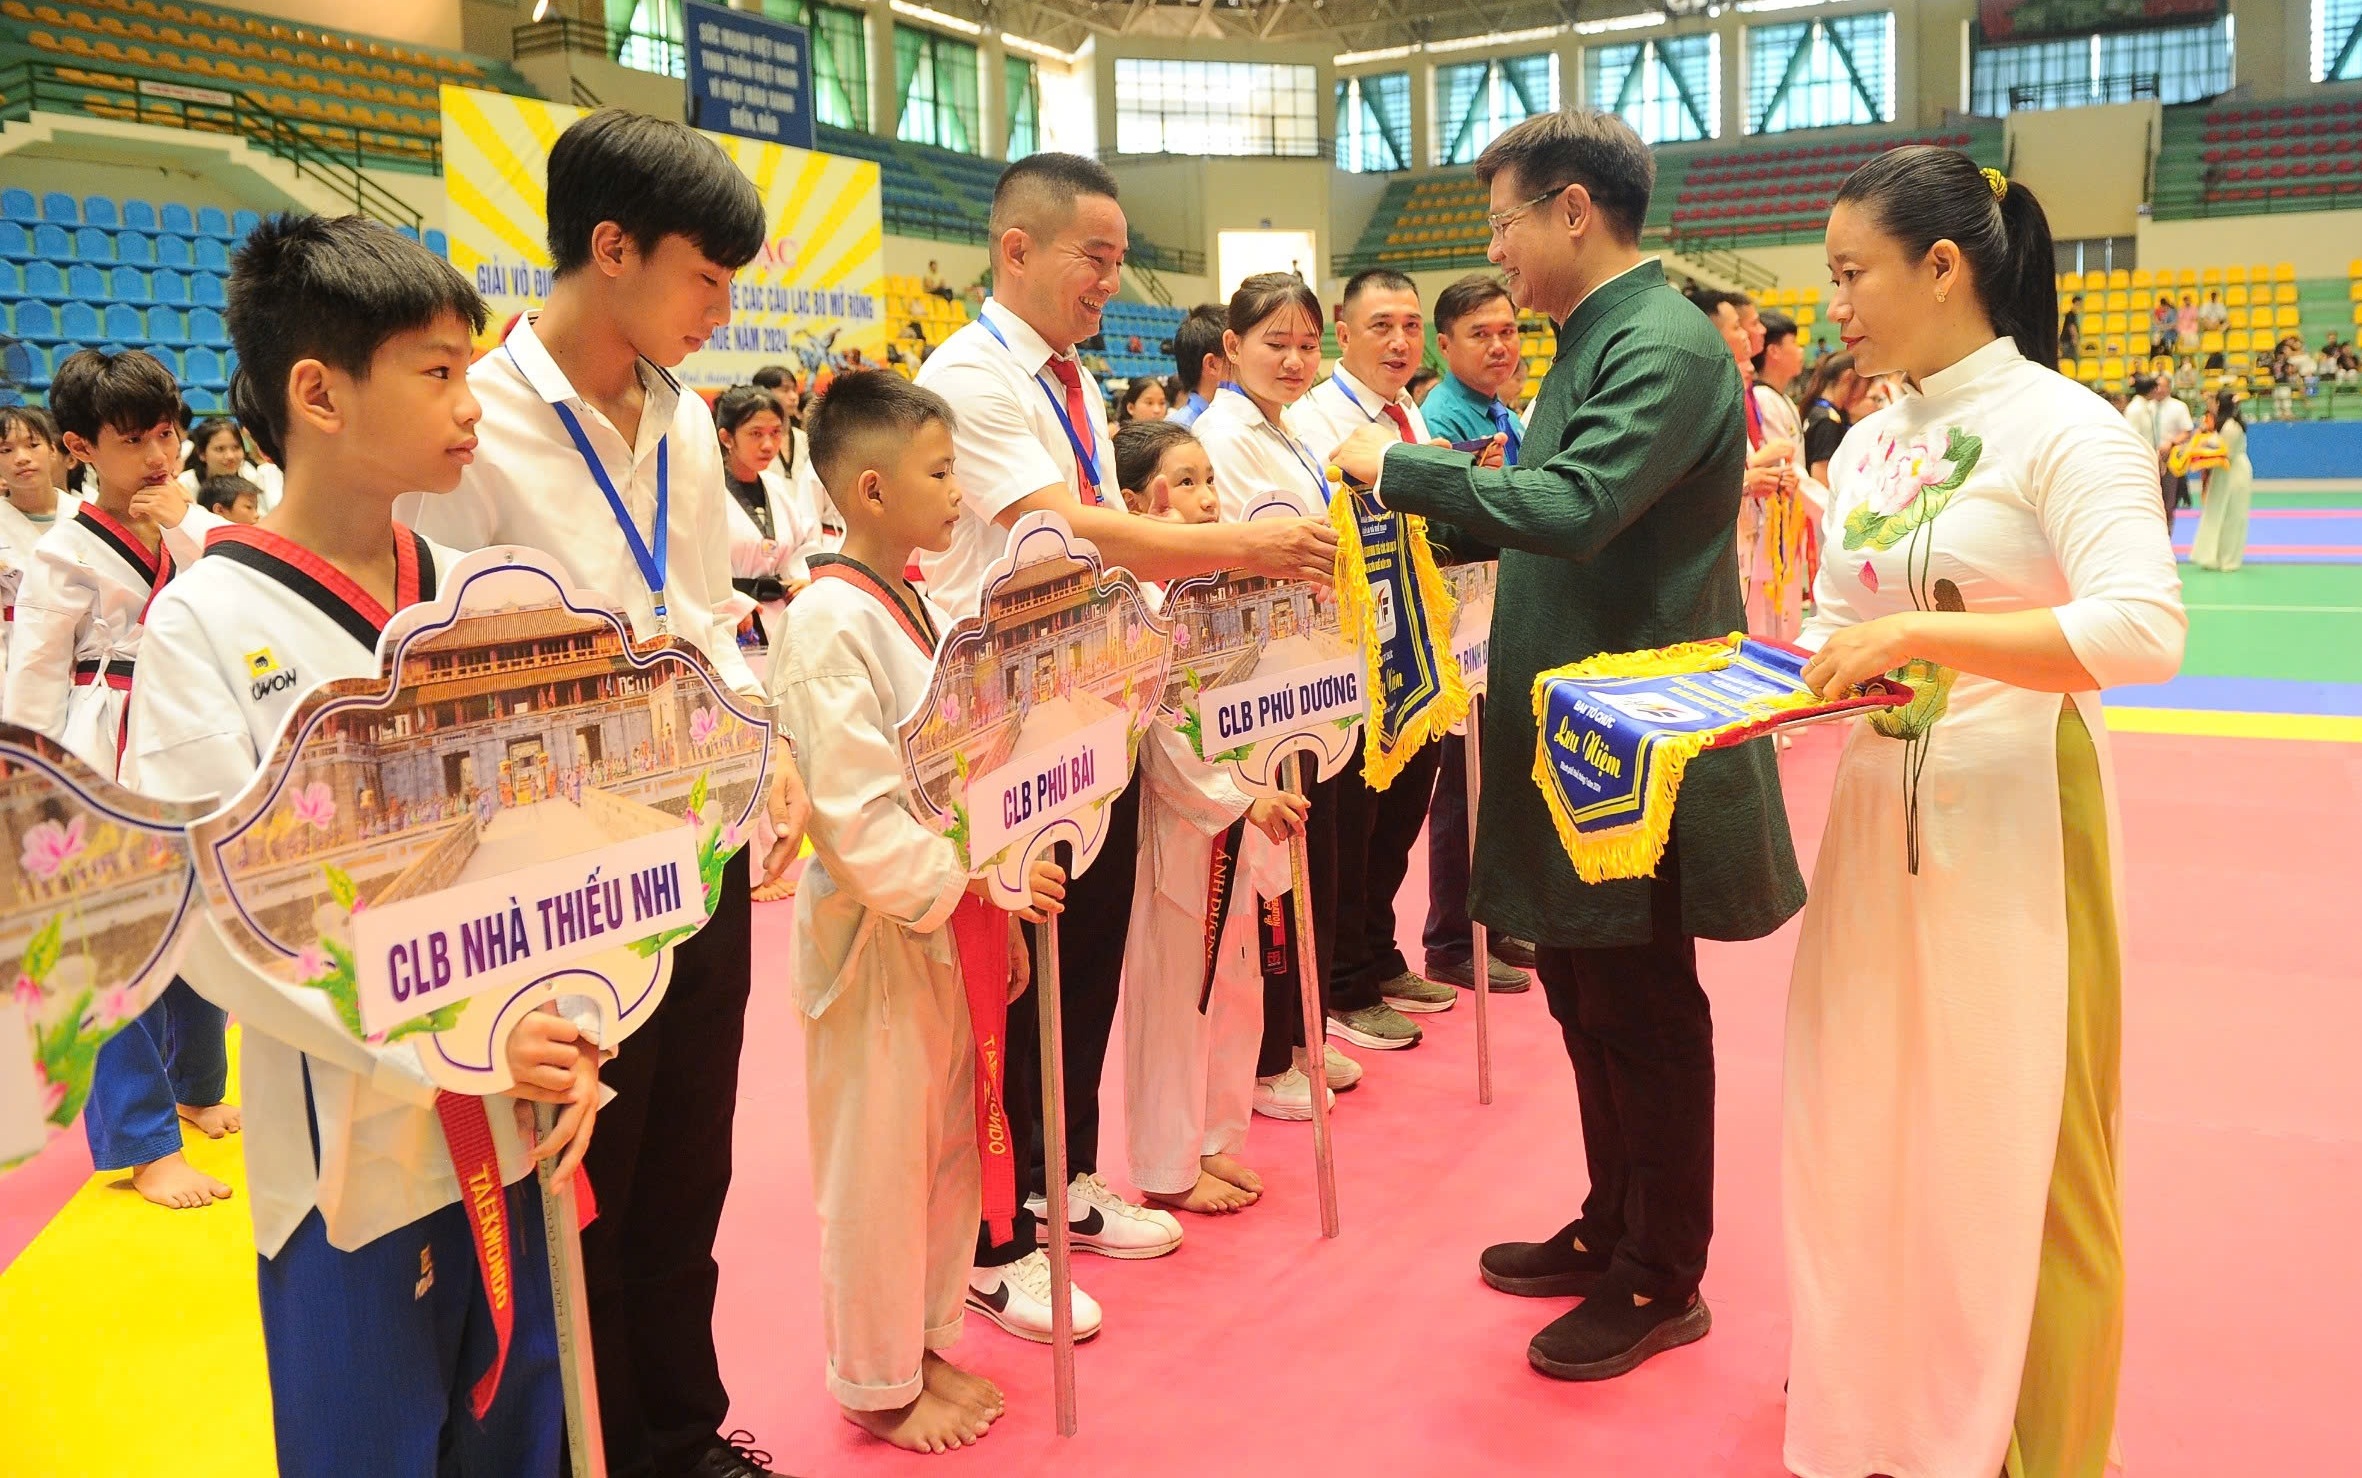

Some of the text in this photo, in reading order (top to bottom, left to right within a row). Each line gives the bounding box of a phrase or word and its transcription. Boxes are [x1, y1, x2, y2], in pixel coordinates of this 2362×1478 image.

[734, 321, 760, 351] NĂM
[764, 327, 788, 352] 2024
[1463, 642, 1482, 675] BÌNH
[1218, 672, 1358, 738] CLB PHÚ DƯƠNG
[1553, 715, 1621, 778] Lưu Niệm
[1003, 745, 1095, 830] CLB PHÚ BÀI
[1213, 849, 1231, 895] ÁNH
[390, 862, 682, 1001] CLB NHÀ THIẾU NHI
[468, 1163, 509, 1310] TAEKWONDO
